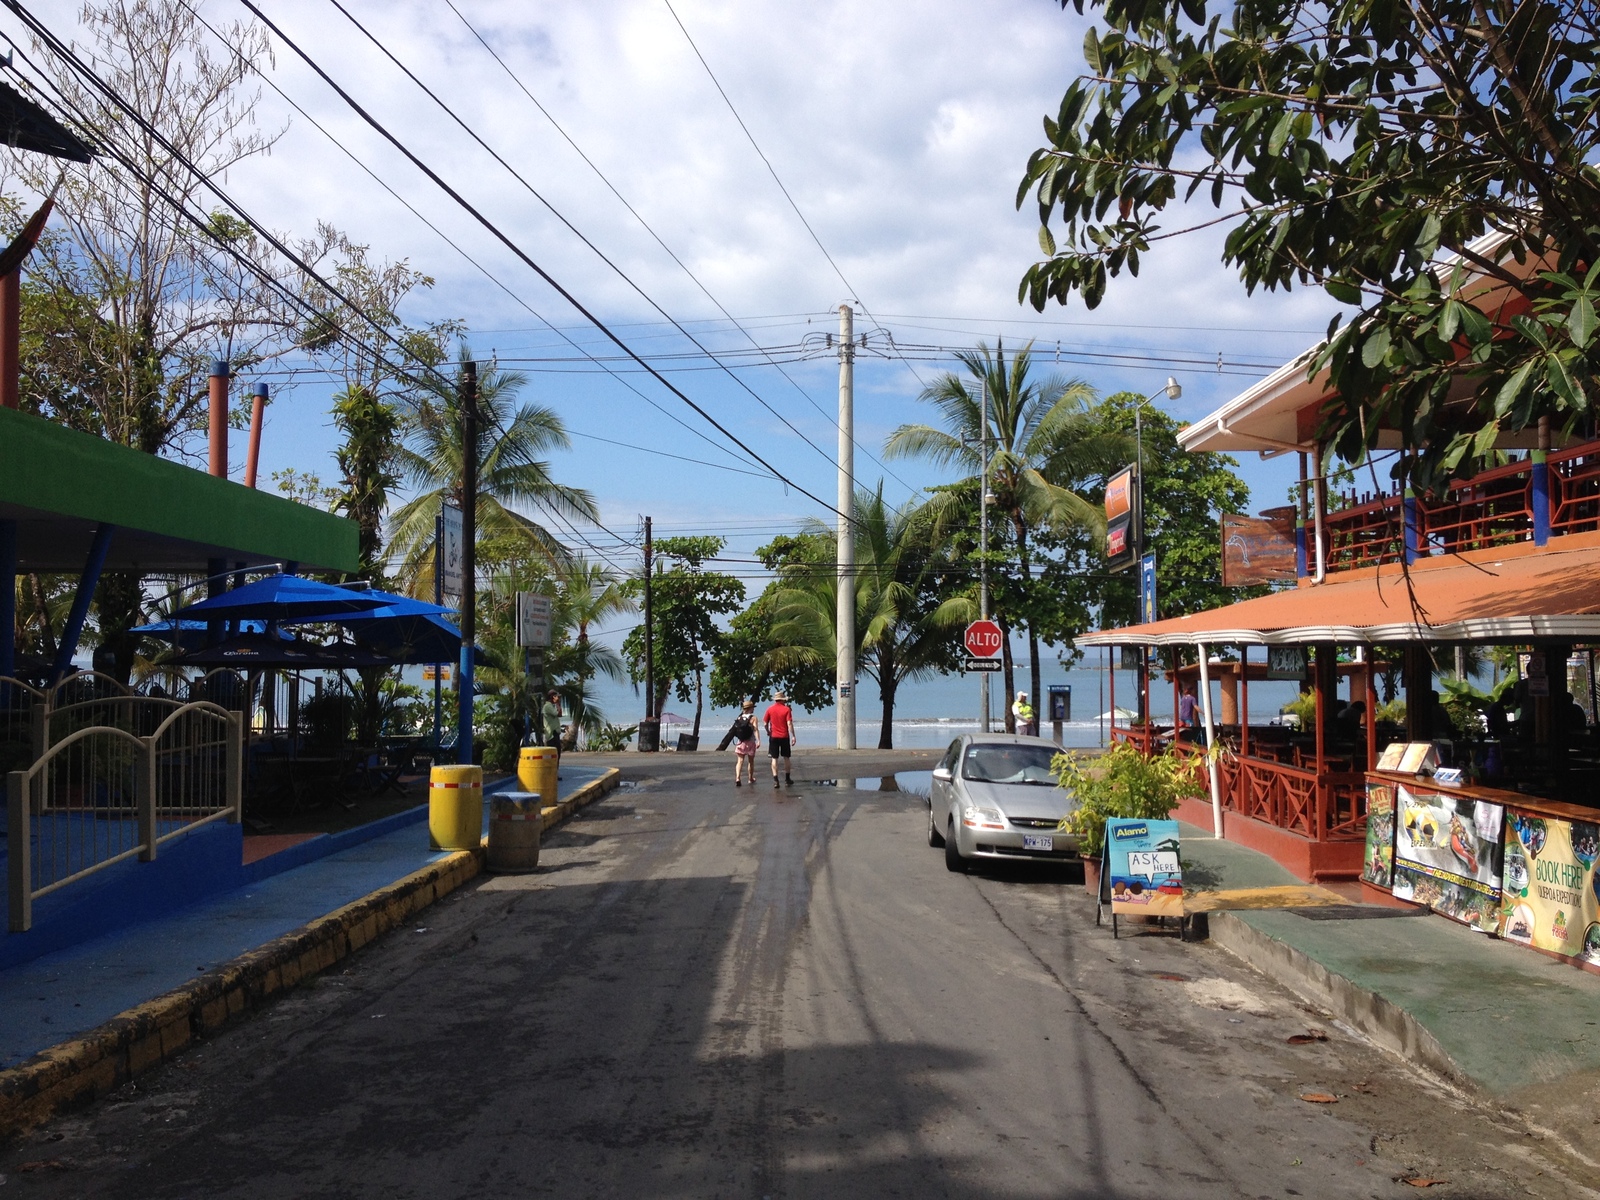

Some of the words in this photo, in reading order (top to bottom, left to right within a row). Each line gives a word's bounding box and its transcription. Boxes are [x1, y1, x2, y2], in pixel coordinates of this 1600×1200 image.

[967, 632, 999, 647] ALTO
[1117, 827, 1147, 837] Alamo
[1132, 853, 1159, 865] ASK
[1153, 863, 1175, 872] HERE
[1536, 858, 1561, 885] BOOK
[1561, 863, 1583, 890] HERE!
